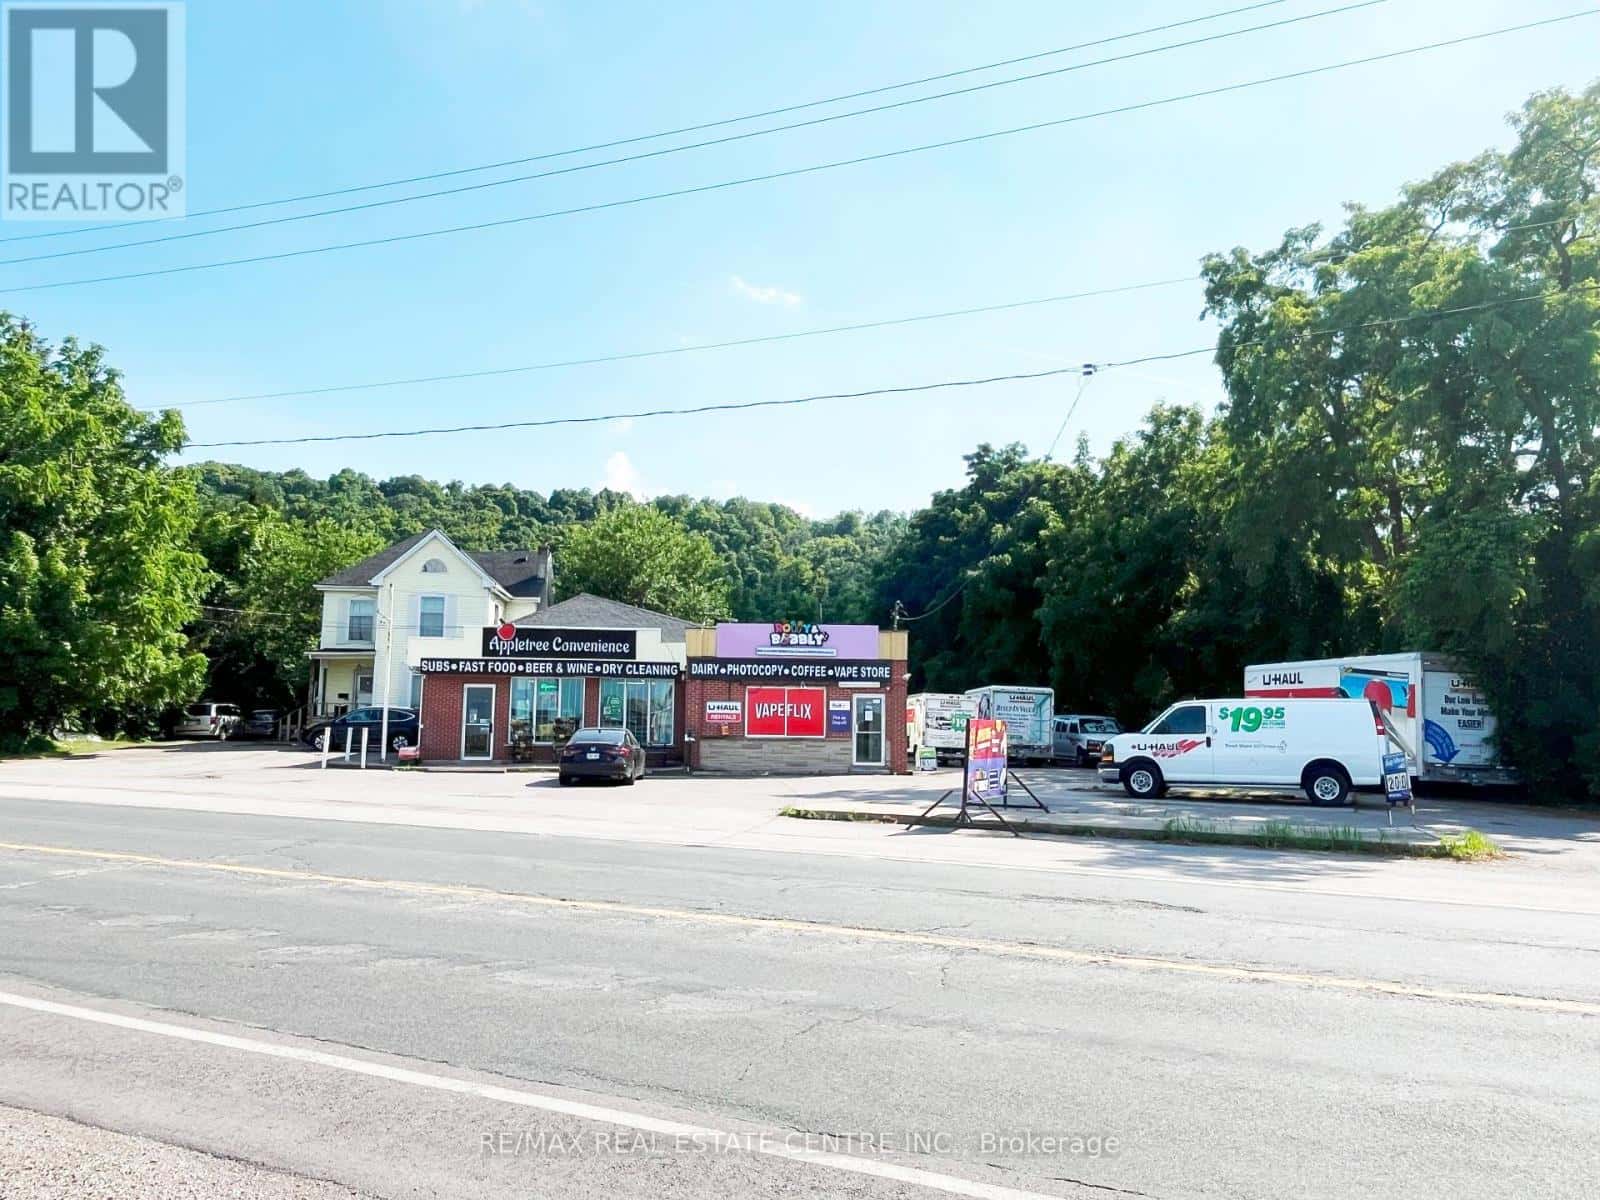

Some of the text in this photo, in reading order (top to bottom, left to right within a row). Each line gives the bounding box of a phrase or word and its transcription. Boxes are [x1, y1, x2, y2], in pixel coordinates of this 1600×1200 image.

[489, 637, 630, 655] Appletree Convenience
[421, 659, 679, 675] SUBS FAST FOOD BEER & WINE DRY CLEANING
[691, 663, 890, 678] DAIRY PHOTOCOPY COFFEE VAPE STORE
[1262, 671, 1304, 686] U-HAUL
